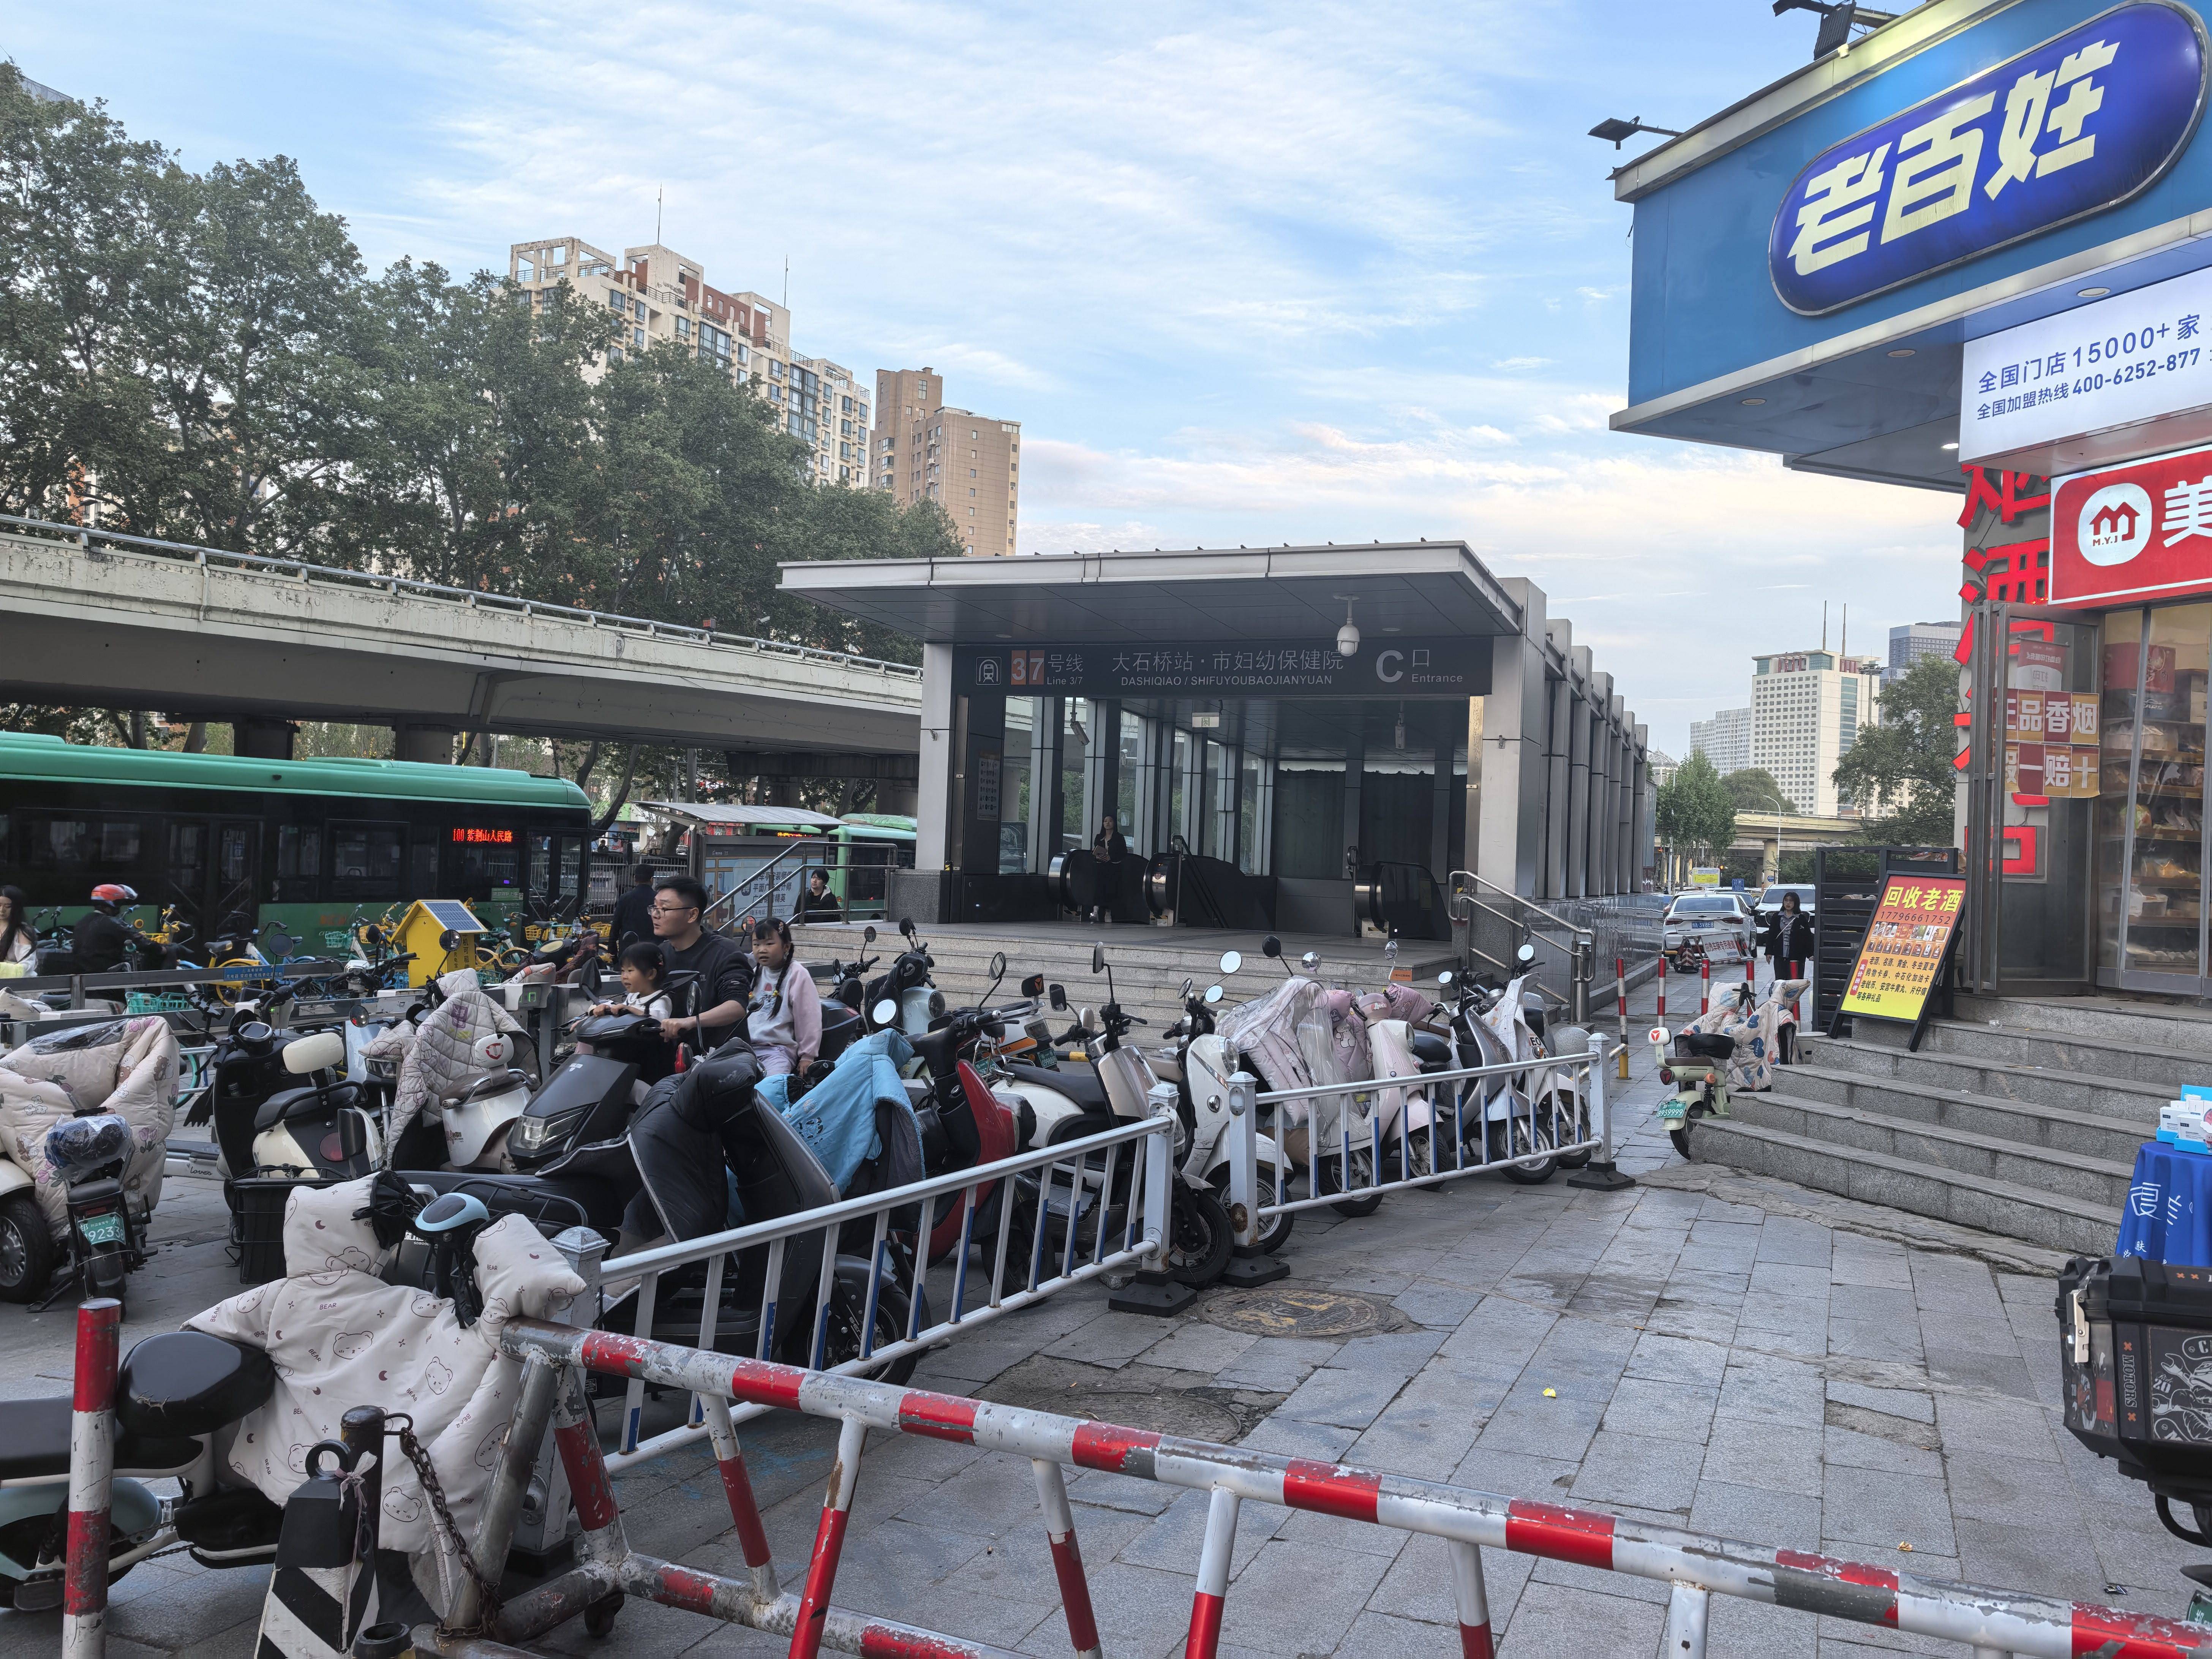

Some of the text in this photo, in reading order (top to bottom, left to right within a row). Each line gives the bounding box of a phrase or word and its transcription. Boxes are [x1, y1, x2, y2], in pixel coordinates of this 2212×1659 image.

[1787, 39, 2120, 276] 老百姓
[1047, 676, 1083, 685] Line 3/7
[1121, 676, 1181, 686] DASHIQIAO
[1191, 675, 1332, 686] SHIFUYOUBAOJIANYUAN
[1412, 674, 1463, 683] Entrance
[1883, 886, 1964, 913] 回收老酒
[1880, 912, 1951, 924] 17796661752
[1852, 964, 1866, 991] 高价回收
[1856, 991, 1882, 1003] 等各种礼品
[1657, 1109, 1683, 1117] 8939999
[210, 1307, 220, 1322] BEAR
[308, 1348, 322, 1362] BEAR
[2122, 1354, 2137, 1408] MOTORS
[406, 1388, 417, 1402] BEAR
